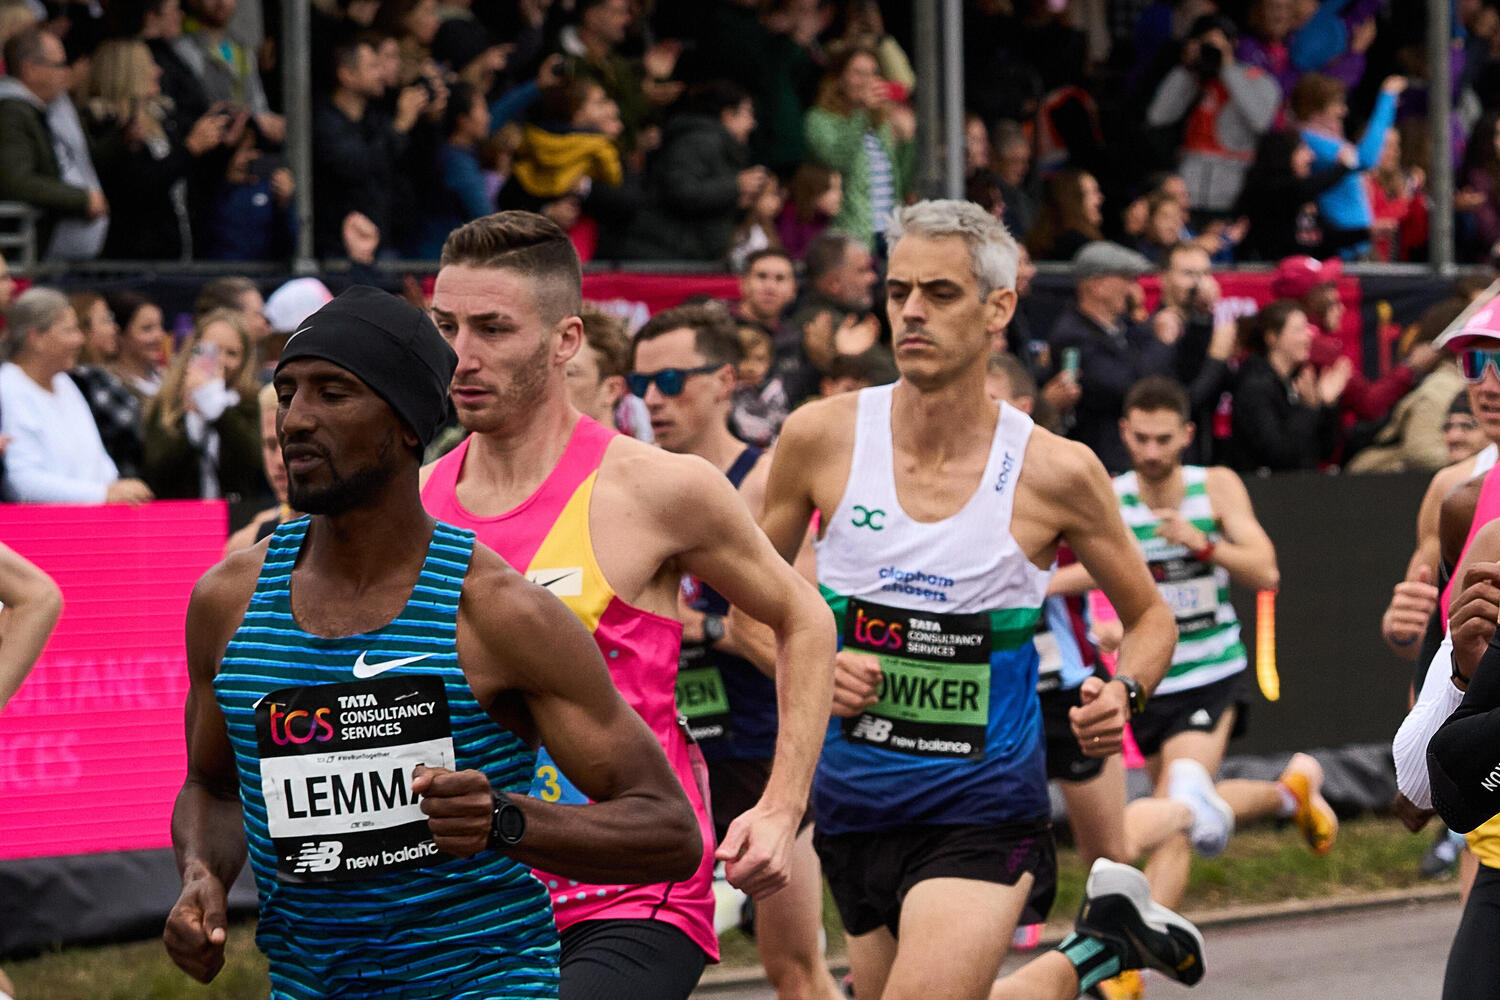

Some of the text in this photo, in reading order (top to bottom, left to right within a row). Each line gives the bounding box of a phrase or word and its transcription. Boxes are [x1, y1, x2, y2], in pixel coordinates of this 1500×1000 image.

[879, 566, 954, 587] clapham
[855, 608, 902, 649] tcs
[908, 618, 941, 632] TATA
[907, 631, 984, 646] CONSULTANCY
[907, 642, 956, 657] SERVICES
[338, 693, 378, 709] TATA
[878, 671, 980, 711] OWKER
[340, 702, 435, 724] CONSULTANCY
[270, 703, 334, 746] tcs
[341, 722, 402, 741] SERVICES
[891, 735, 972, 754] new balance
[536, 765, 561, 802] 3
[346, 843, 439, 870] new balanc
